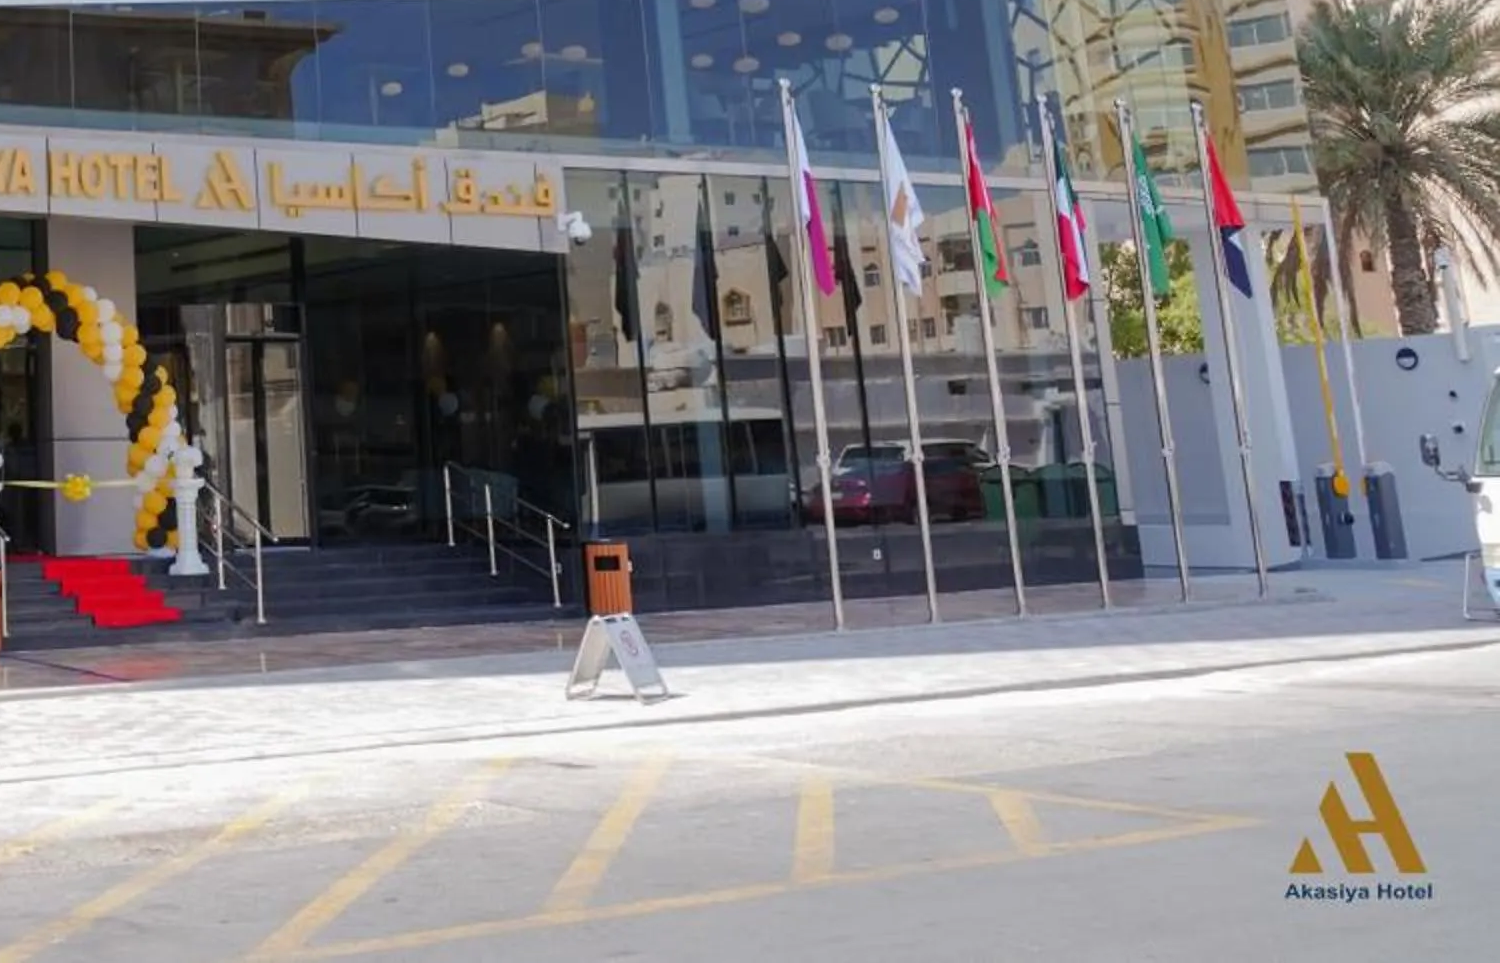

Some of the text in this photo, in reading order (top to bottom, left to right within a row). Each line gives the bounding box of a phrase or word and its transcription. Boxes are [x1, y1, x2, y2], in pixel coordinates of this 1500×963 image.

[48, 150, 183, 203] HOTEL
[264, 155, 556, 218] فندق أكاسيا
